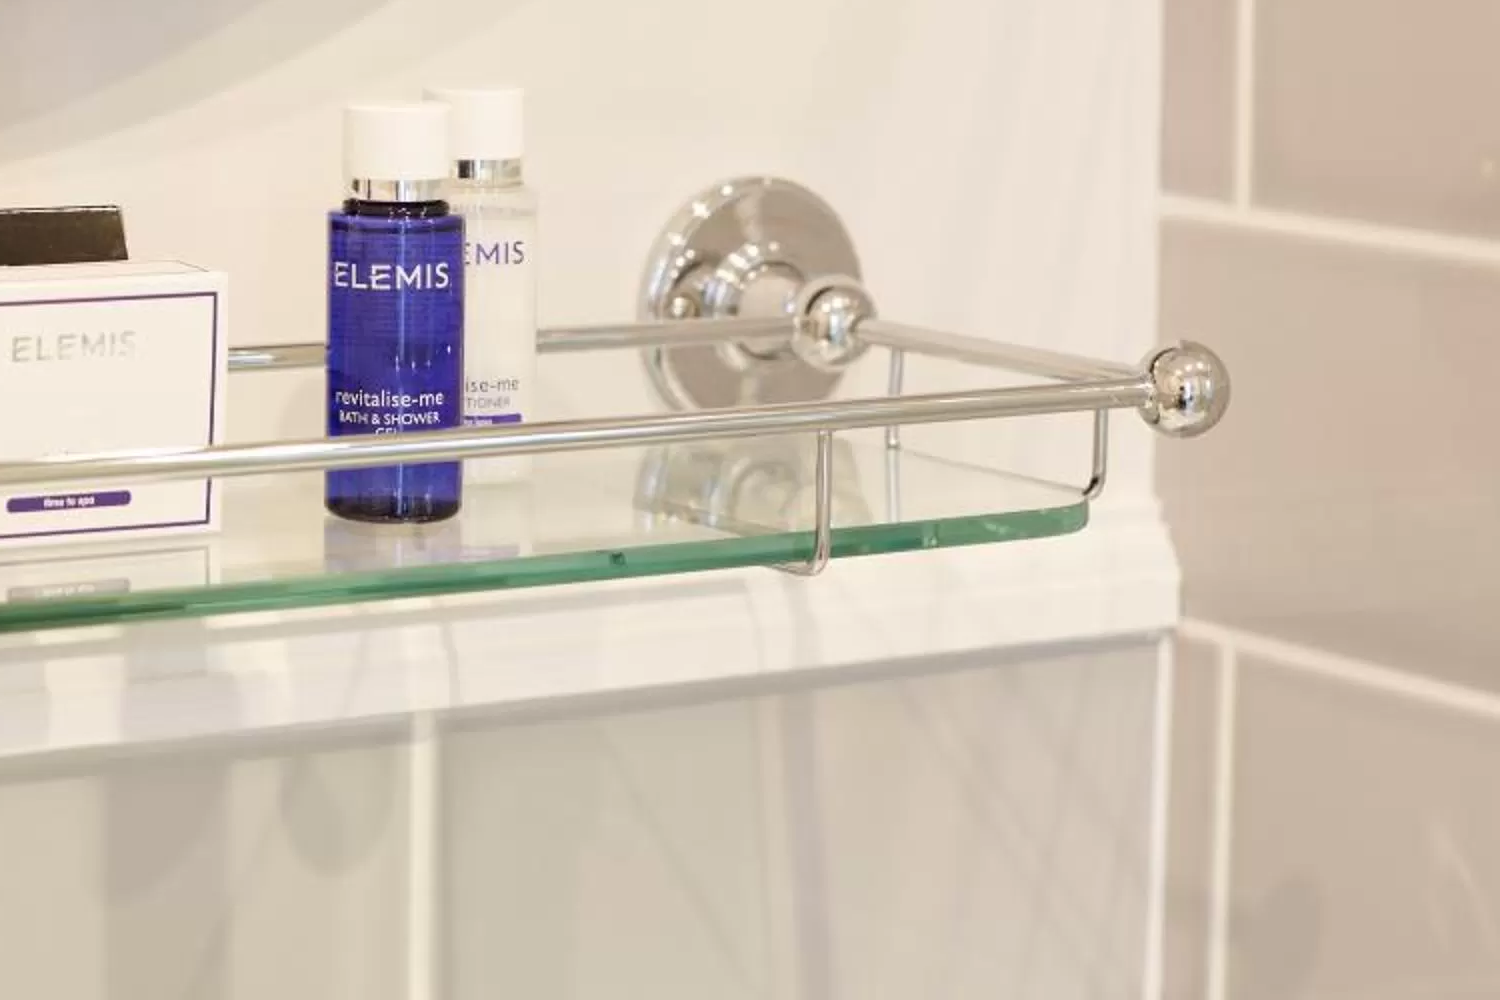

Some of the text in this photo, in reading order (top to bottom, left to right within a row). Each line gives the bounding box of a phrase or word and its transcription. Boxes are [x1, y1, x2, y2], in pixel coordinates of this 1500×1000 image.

[334, 261, 451, 291] ELEMIS
[11, 330, 137, 363] ELEMIS
[335, 389, 445, 408] revitalise-me
[339, 410, 441, 426] BATH & SHOWER
